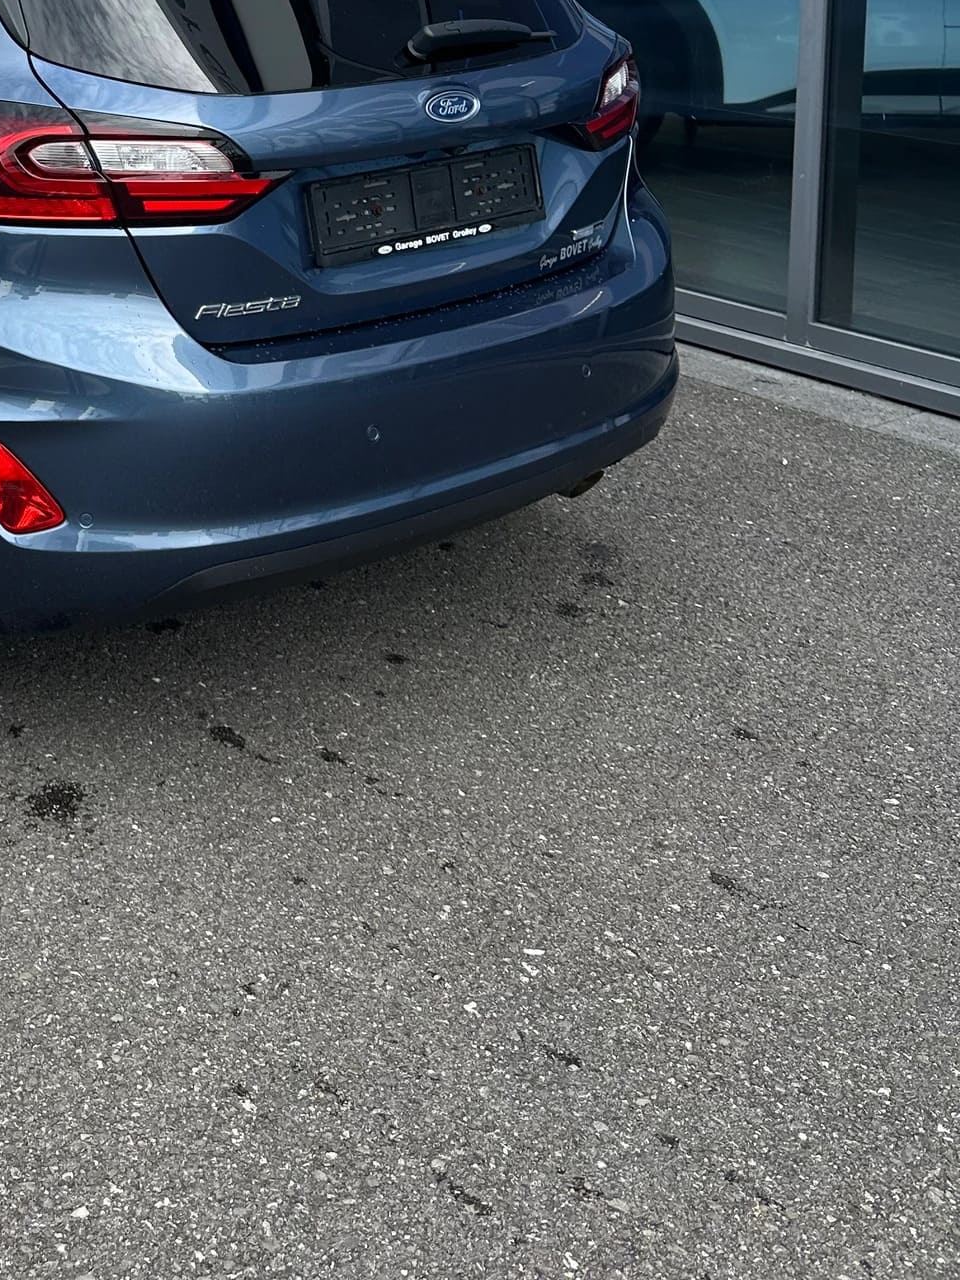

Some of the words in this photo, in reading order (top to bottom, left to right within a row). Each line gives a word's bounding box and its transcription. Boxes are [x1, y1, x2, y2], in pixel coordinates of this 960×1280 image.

[439, 97, 468, 116] Ford
[394, 239, 423, 251] Garage
[425, 231, 450, 245] BOVET
[560, 239, 588, 261] BOVET
[194, 295, 302, 320] Fiesta
